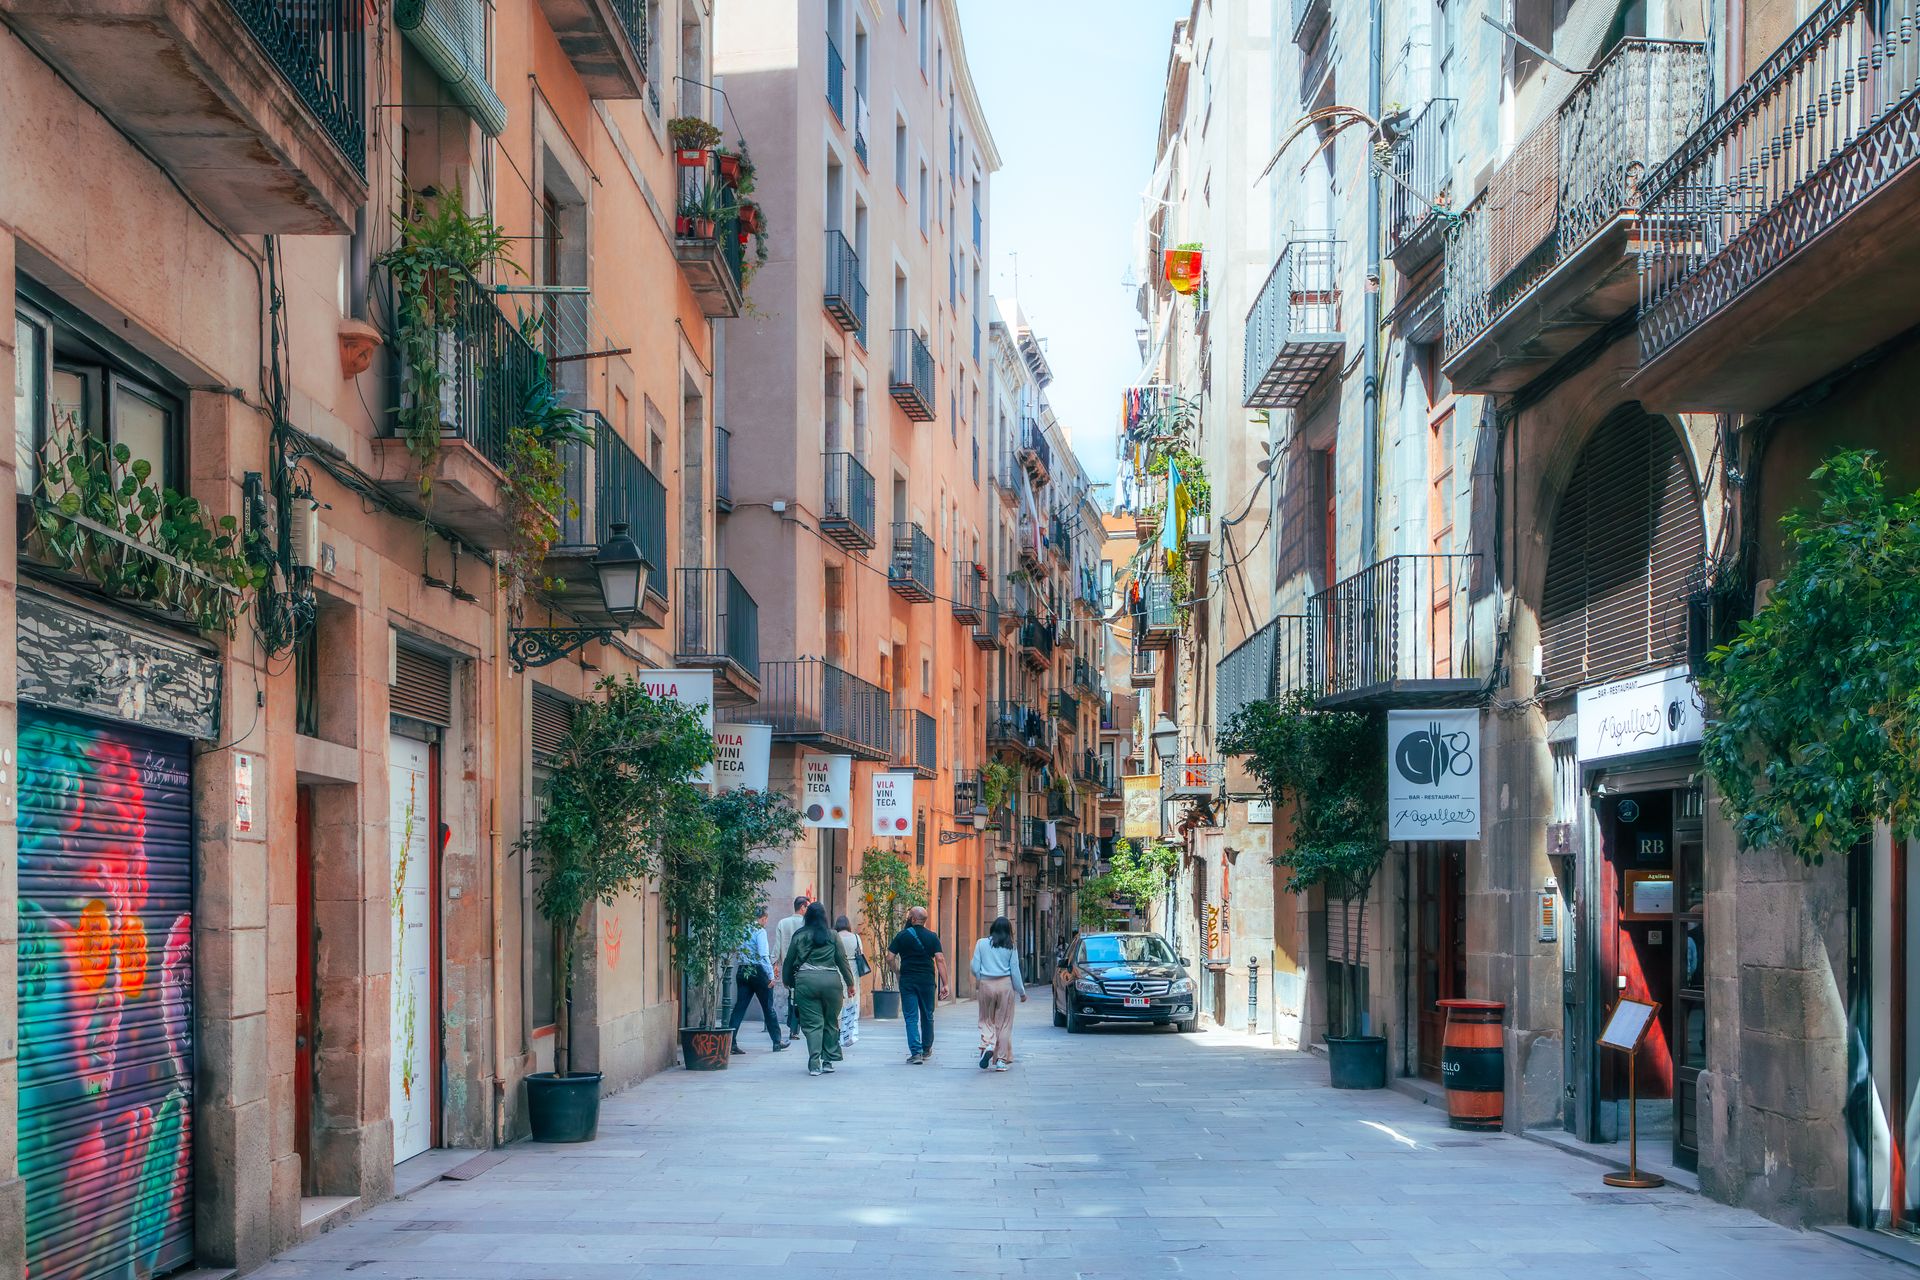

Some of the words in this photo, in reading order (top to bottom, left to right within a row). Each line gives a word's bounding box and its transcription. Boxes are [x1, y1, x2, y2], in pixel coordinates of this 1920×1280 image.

[646, 684, 678, 697] VILA
[1598, 688, 1607, 698] BAR
[1610, 681, 1638, 694] RESTAURANT
[717, 734, 743, 746] VILA
[717, 747, 740, 759] VINI
[716, 760, 745, 772] TECA
[808, 762, 829, 772] VILA
[807, 773, 826, 783] VINI
[807, 783, 831, 793] TECA
[876, 780, 894, 789] VILA
[876, 789, 893, 798] VINI
[876, 798, 897, 807] TECA
[1640, 839, 1665, 854] RB
